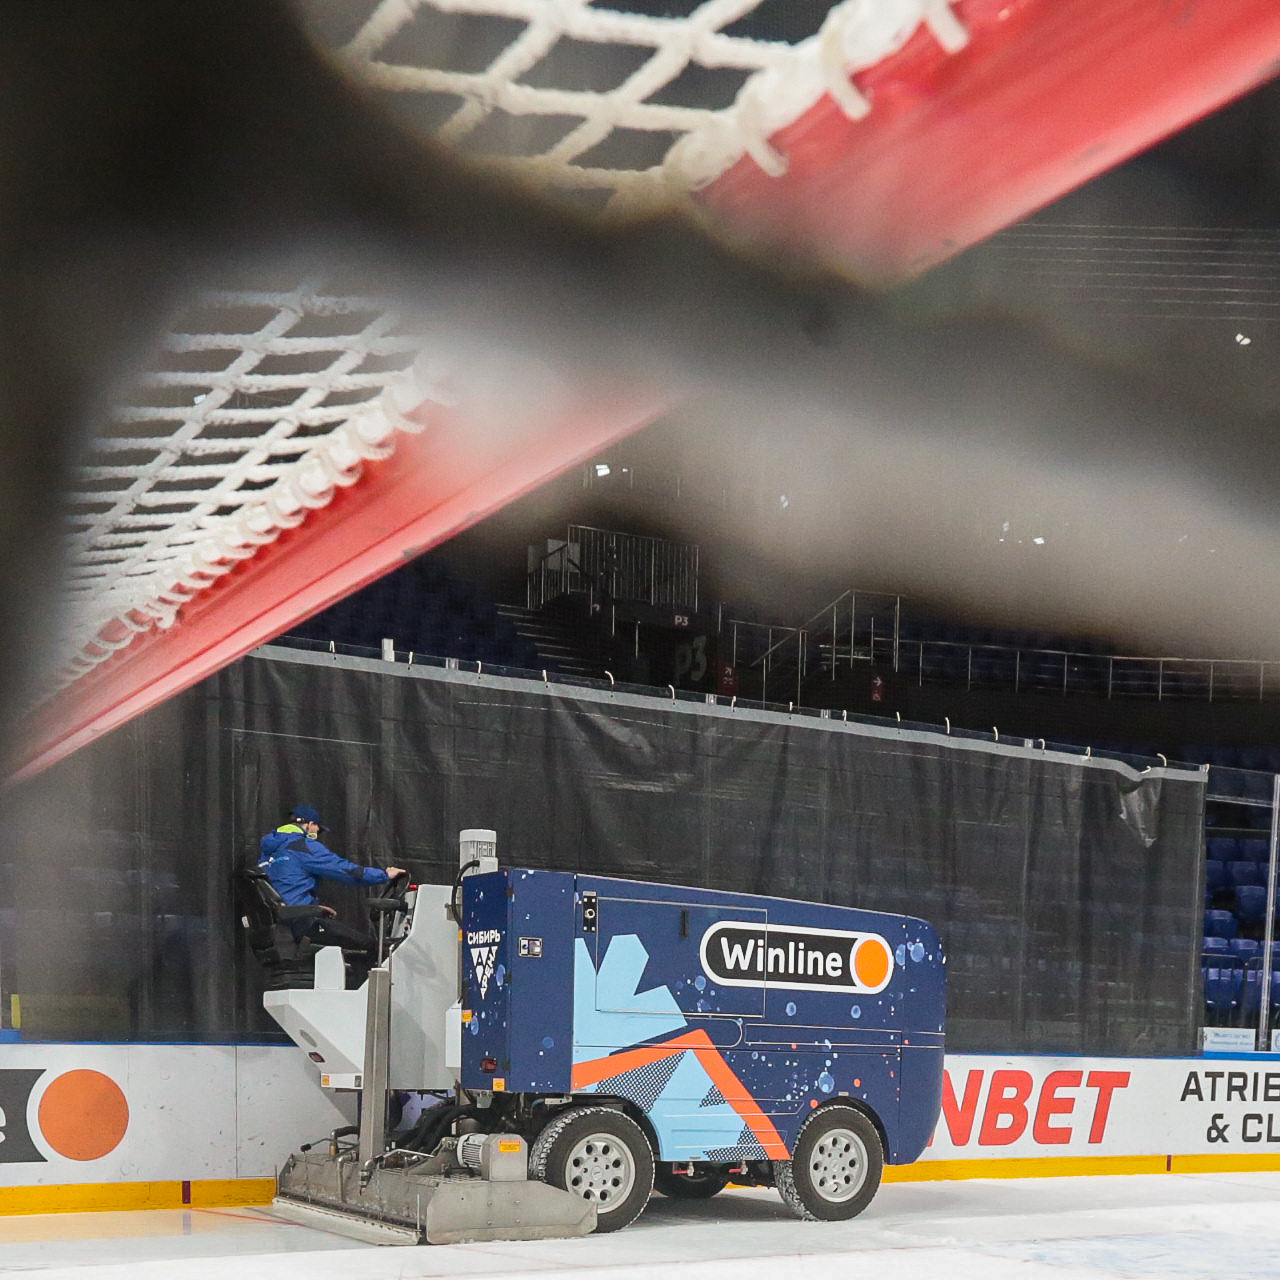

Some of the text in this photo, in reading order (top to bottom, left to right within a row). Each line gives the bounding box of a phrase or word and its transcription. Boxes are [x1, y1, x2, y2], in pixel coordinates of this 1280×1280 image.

[467, 929, 501, 945] СИБИРЬ
[720, 936, 843, 978] Winline
[1206, 1114, 1231, 1143] &
